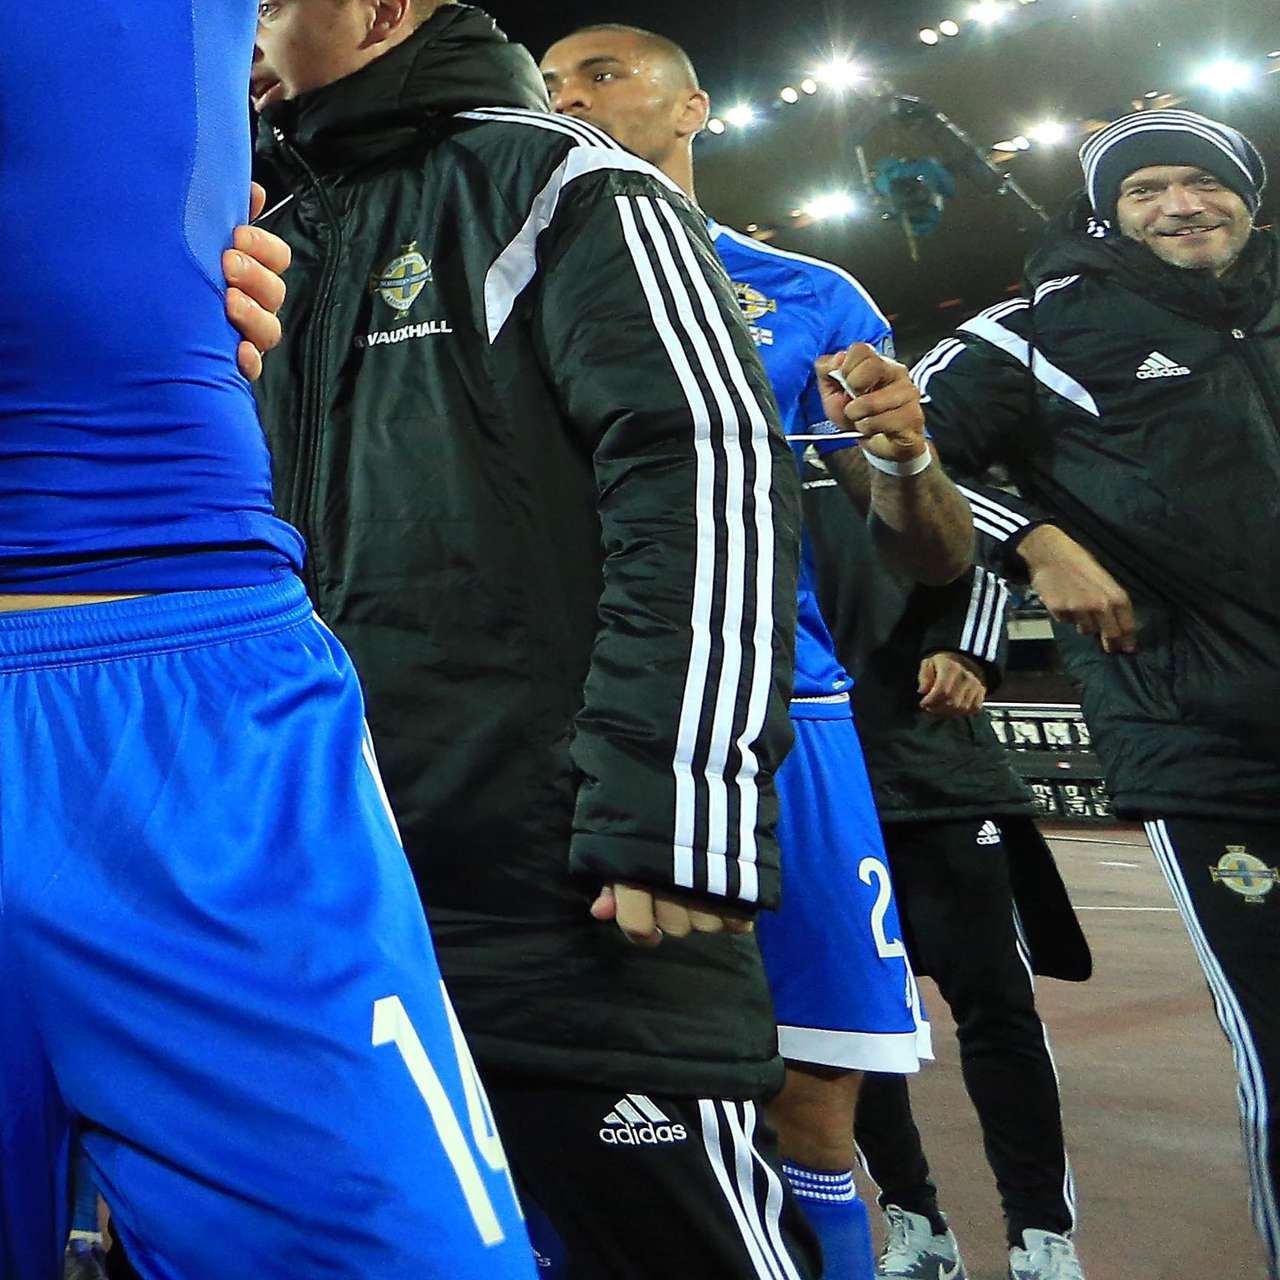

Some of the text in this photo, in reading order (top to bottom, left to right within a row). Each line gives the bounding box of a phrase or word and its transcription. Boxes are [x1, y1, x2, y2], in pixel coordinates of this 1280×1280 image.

[367, 320, 453, 347] VAUXHALL
[1135, 366, 1192, 380] adidas
[599, 1121, 688, 1145] adidas
